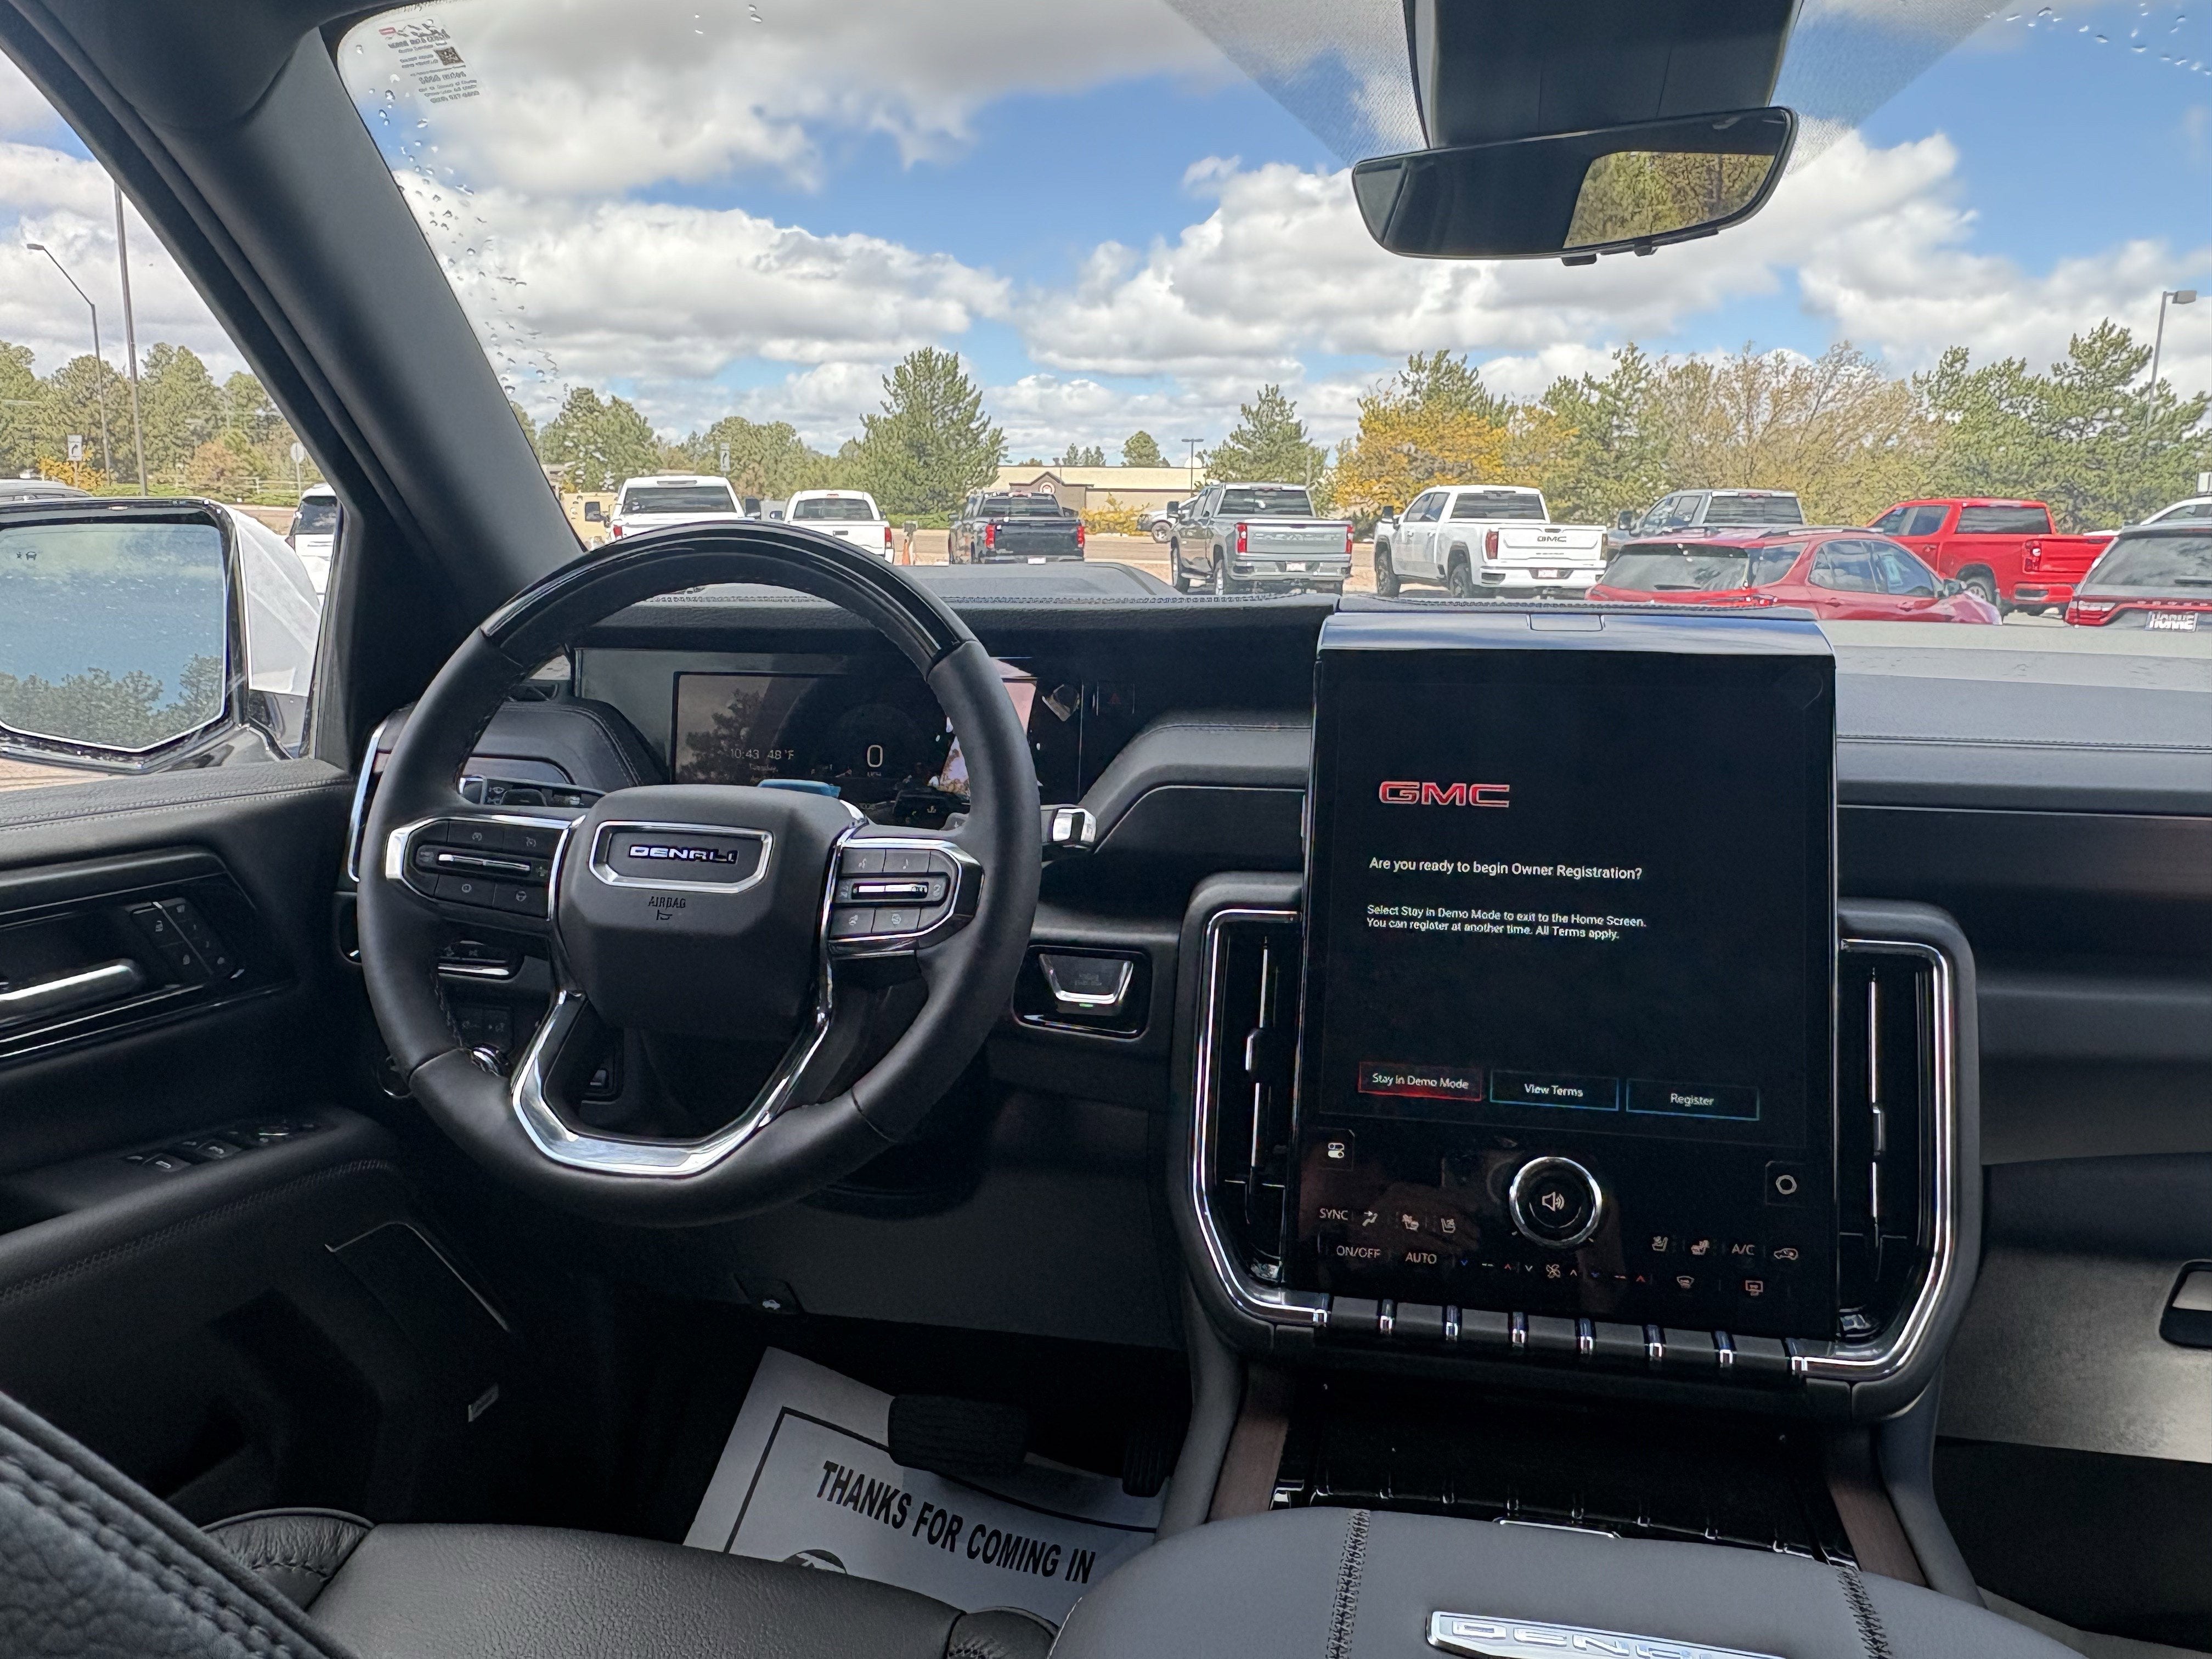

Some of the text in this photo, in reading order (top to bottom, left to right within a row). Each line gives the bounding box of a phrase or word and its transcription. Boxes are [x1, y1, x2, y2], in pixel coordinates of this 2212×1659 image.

[730, 748, 759, 759] 10:43
[768, 750, 781, 760] 48
[867, 744, 883, 768] 0
[1379, 781, 1510, 808] GMC
[629, 846, 738, 864] DENALI
[1369, 857, 1643, 880] Are you ready to begin Owner Registration?
[648, 896, 686, 909] AIRBAG
[1367, 904, 1646, 927] Select Stay in Demo Mode to exit to the Home Screen.
[1367, 917, 1386, 928] You
[1409, 920, 1449, 932] register
[1451, 922, 1461, 931] at
[1464, 923, 1504, 934] another
[1506, 924, 1533, 935] time.
[1536, 926, 1549, 935] All
[1553, 926, 1586, 938] Terms
[1589, 928, 1620, 941] apply.
[1372, 1073, 1393, 1087] Stay
[1407, 1075, 1437, 1087] Demo
[1440, 1077, 1469, 1090] Mode
[1525, 1084, 1583, 1097] View Terms
[1671, 1093, 1714, 1107] Register
[1319, 1208, 1348, 1221] SYNC
[1336, 1245, 1381, 1259] ON/OFF
[1732, 1244, 1755, 1255] A/C
[1405, 1251, 1437, 1264] AUTO
[816, 1460, 1096, 1584] THANKS FOR COMING IN
[1452, 1620, 1713, 1659] DENA
